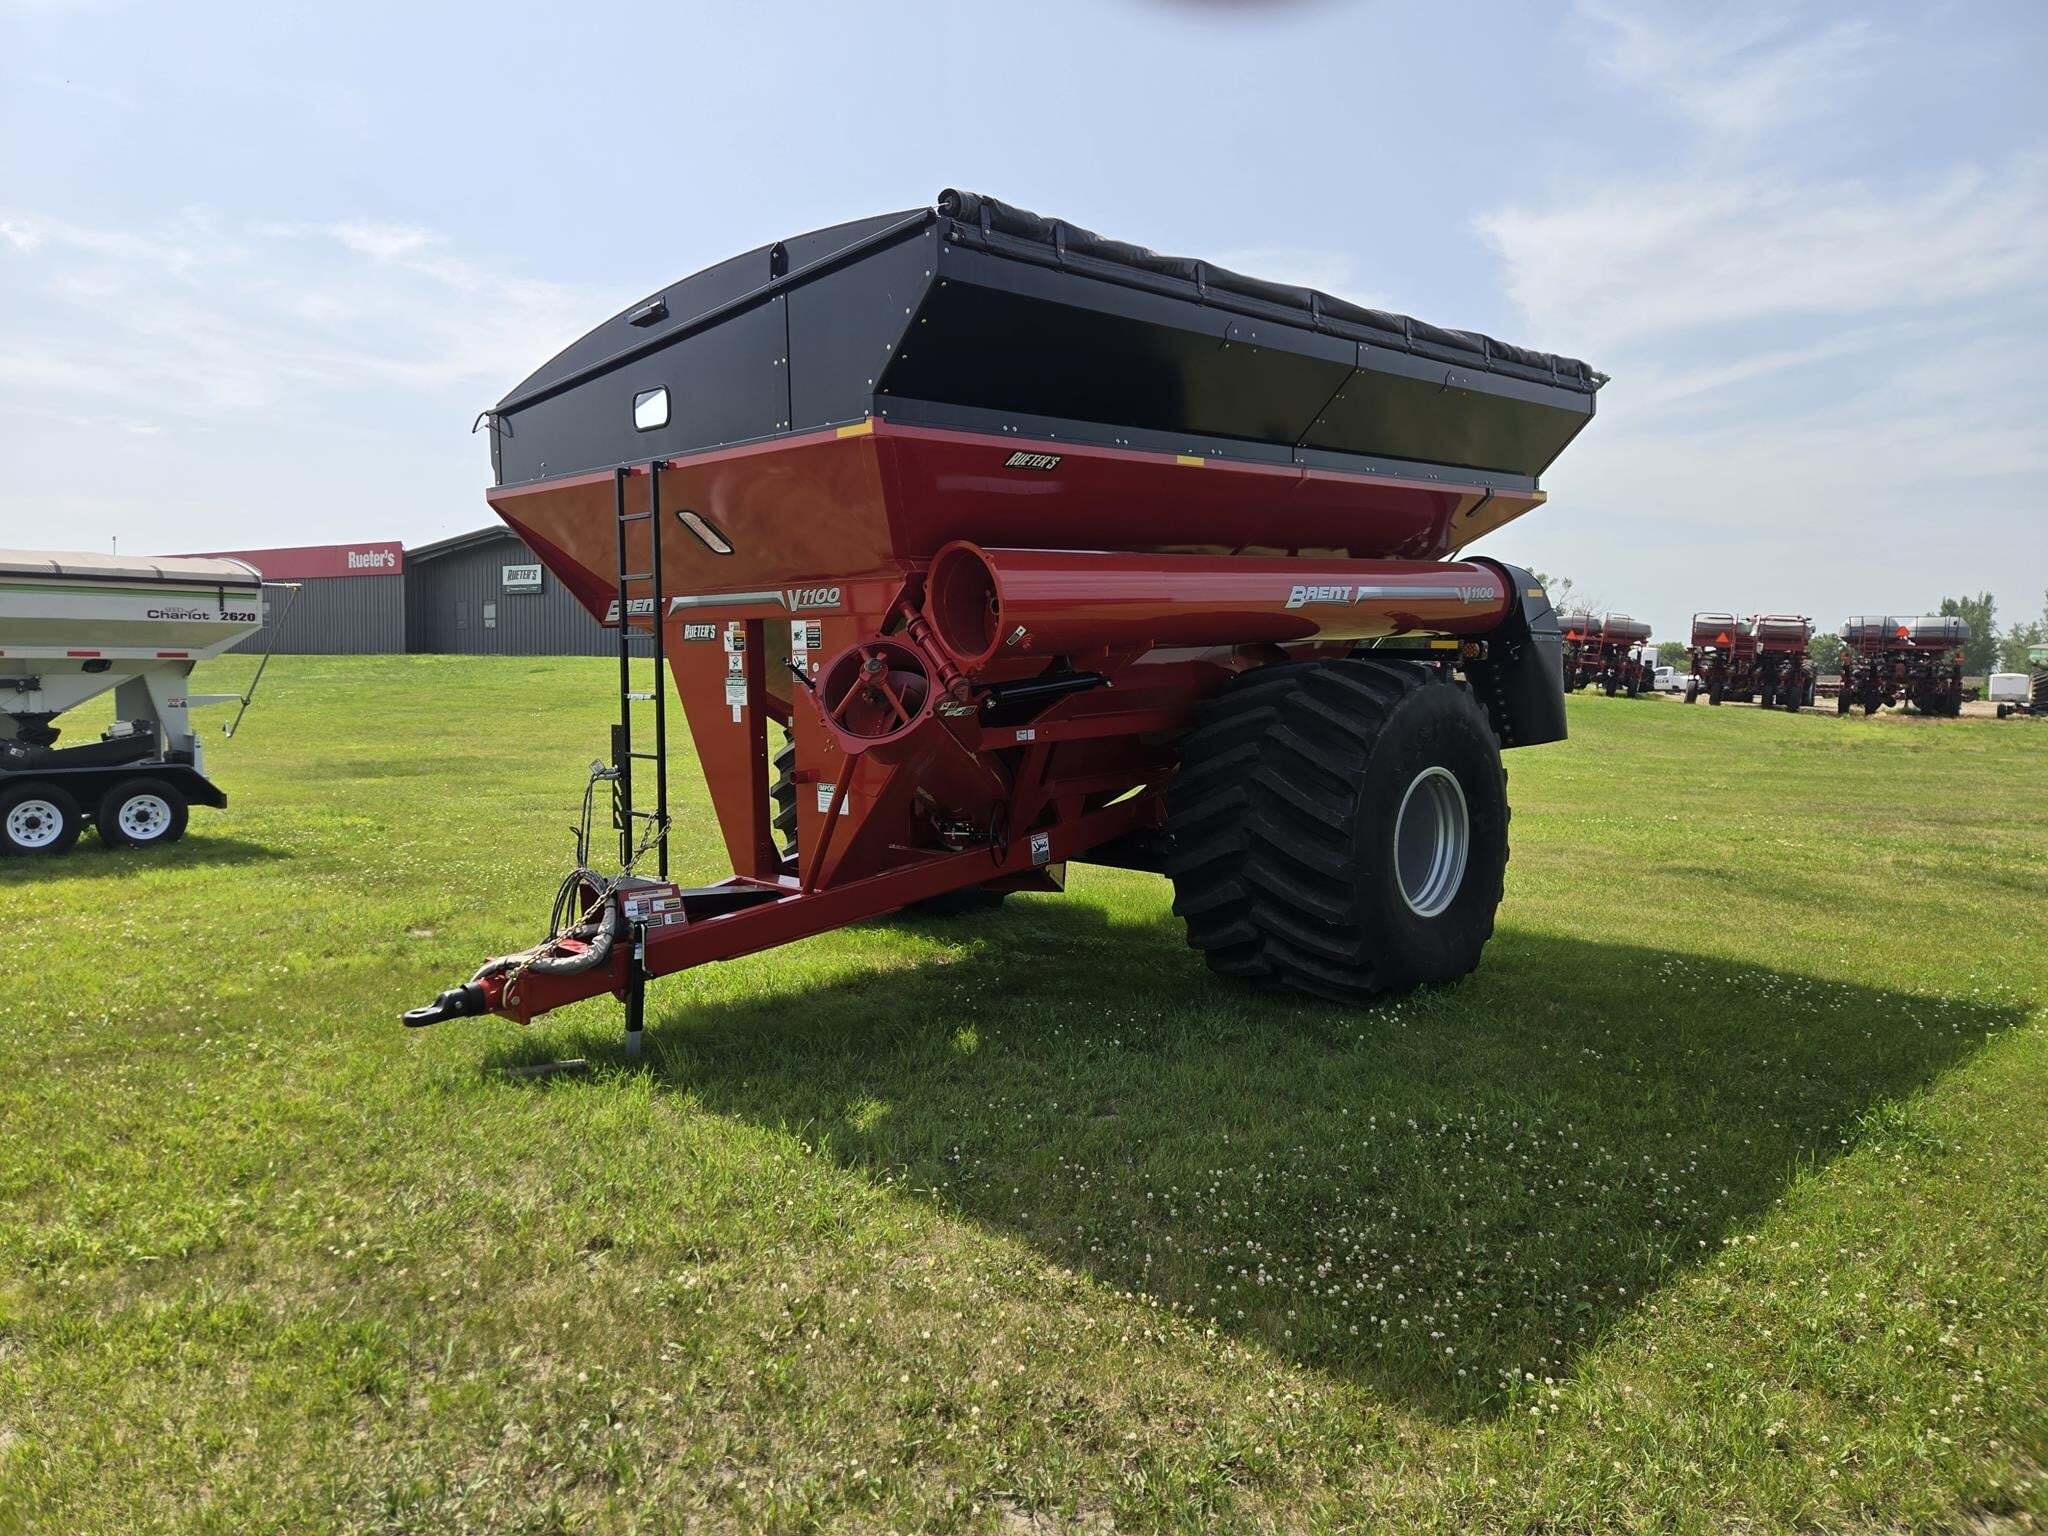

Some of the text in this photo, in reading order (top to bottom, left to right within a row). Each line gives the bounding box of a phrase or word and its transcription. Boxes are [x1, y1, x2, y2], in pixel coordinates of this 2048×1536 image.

[1005, 452, 1061, 469] RUETER'S
[348, 550, 396, 568] Rueter's
[605, 588, 840, 622] BREN V1100
[1285, 586, 1494, 608] BRENT V1100
[147, 609, 256, 621] Chariot 2620
[684, 624, 716, 640] RUETER'S
